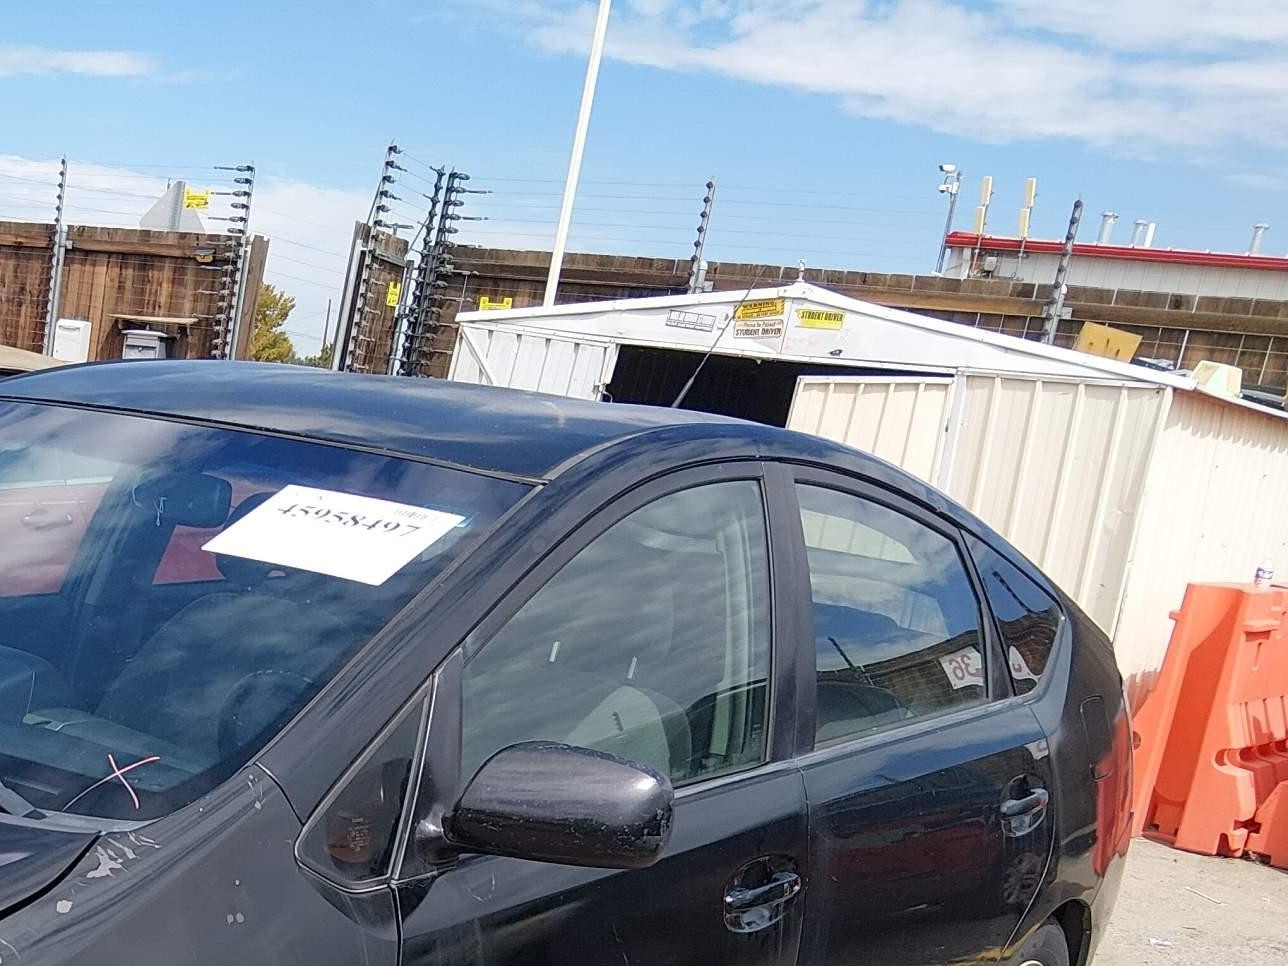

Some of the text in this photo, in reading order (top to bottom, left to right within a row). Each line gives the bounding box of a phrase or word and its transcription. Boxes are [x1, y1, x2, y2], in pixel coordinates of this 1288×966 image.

[800, 311, 844, 321] STUDENT DRIVER
[761, 328, 782, 336] DRIVER
[278, 503, 422, 537] 45958497
